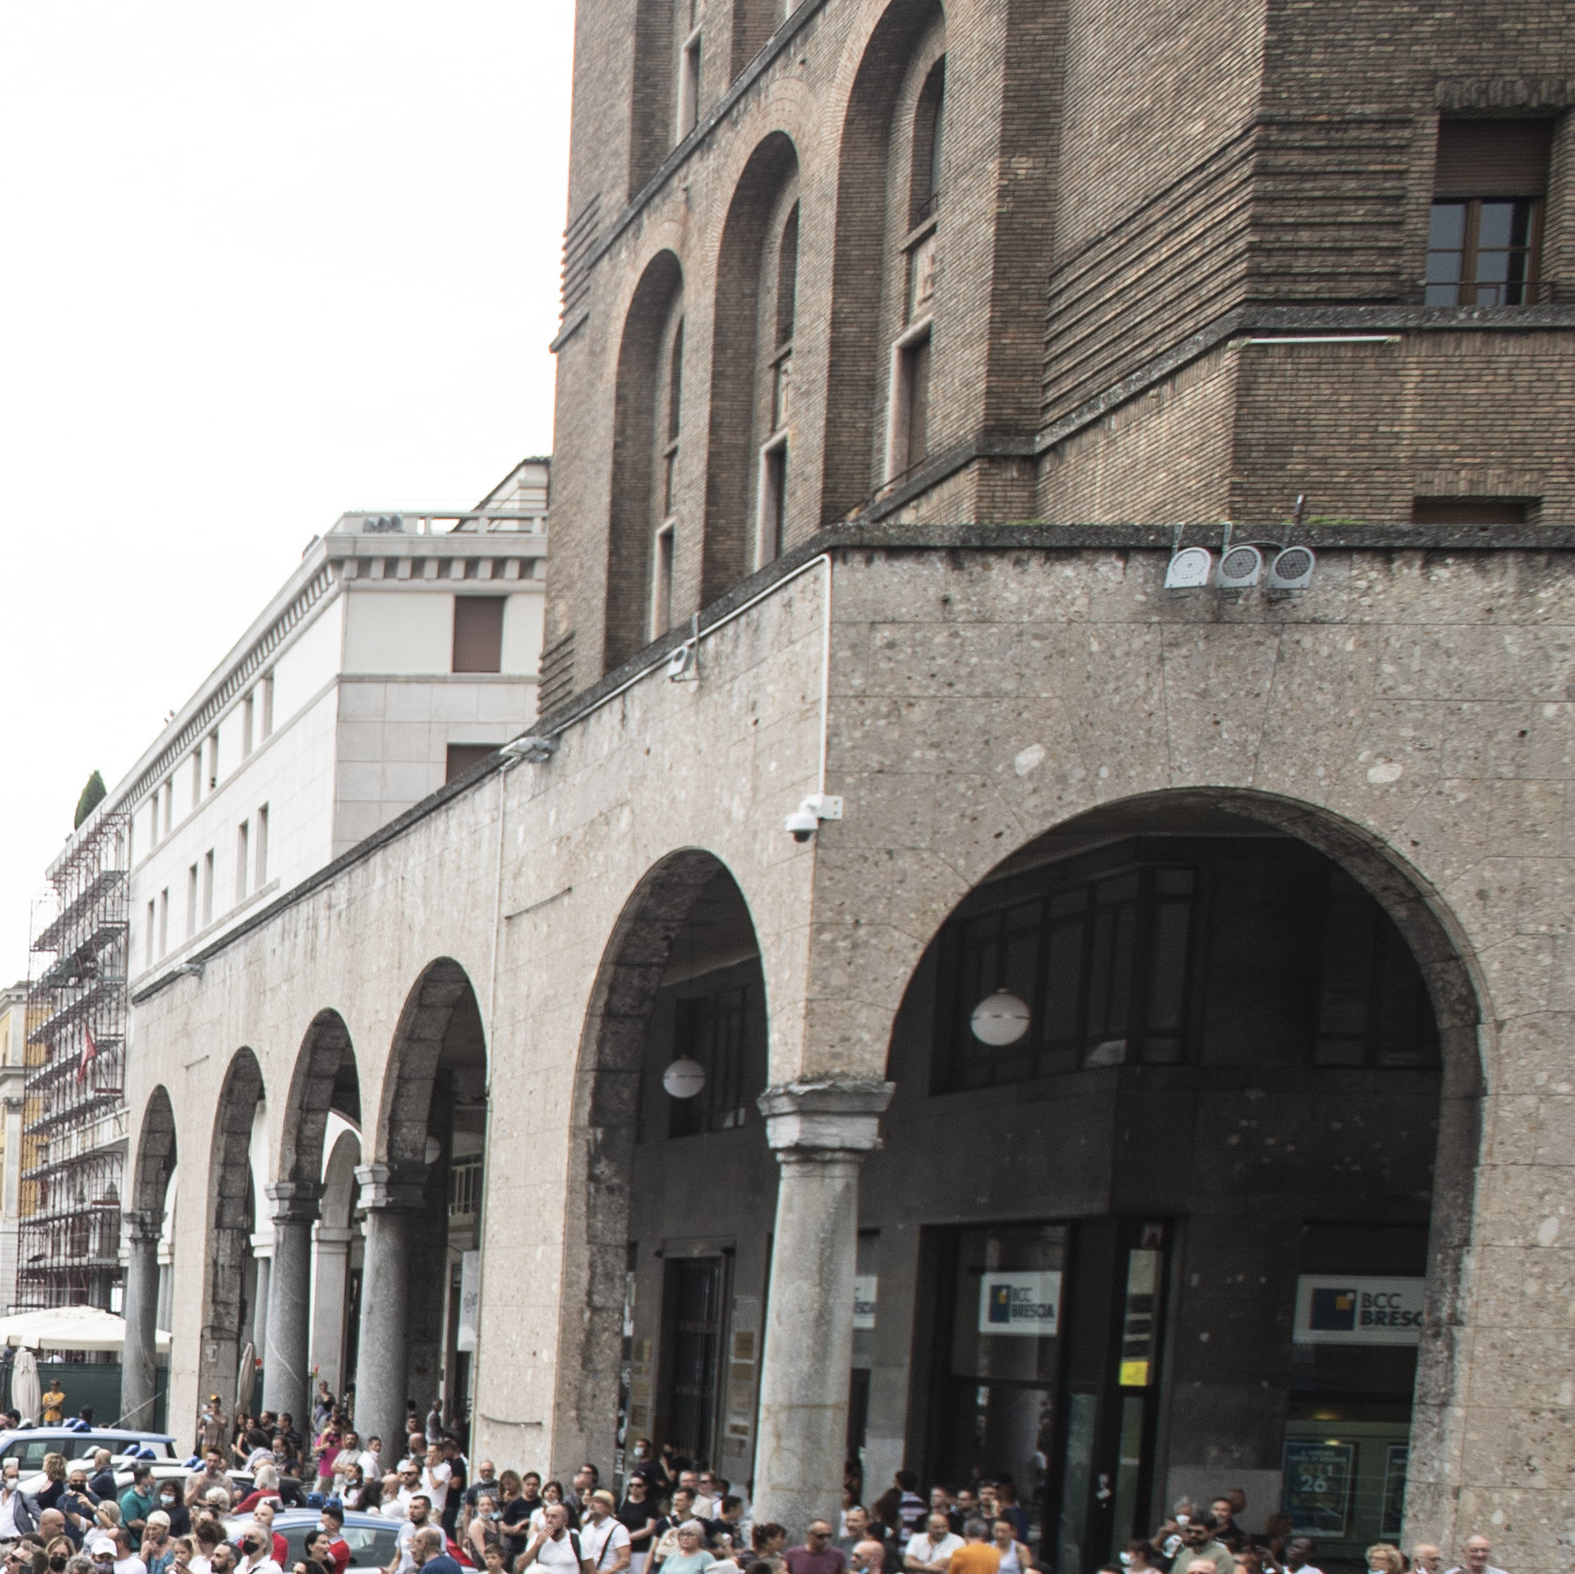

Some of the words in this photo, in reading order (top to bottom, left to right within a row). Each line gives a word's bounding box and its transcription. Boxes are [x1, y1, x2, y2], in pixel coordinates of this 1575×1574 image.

[1012, 1287, 1032, 1301] BCC
[1361, 1292, 1402, 1310] BCC
[1011, 1304, 1055, 1319] BRESCIA
